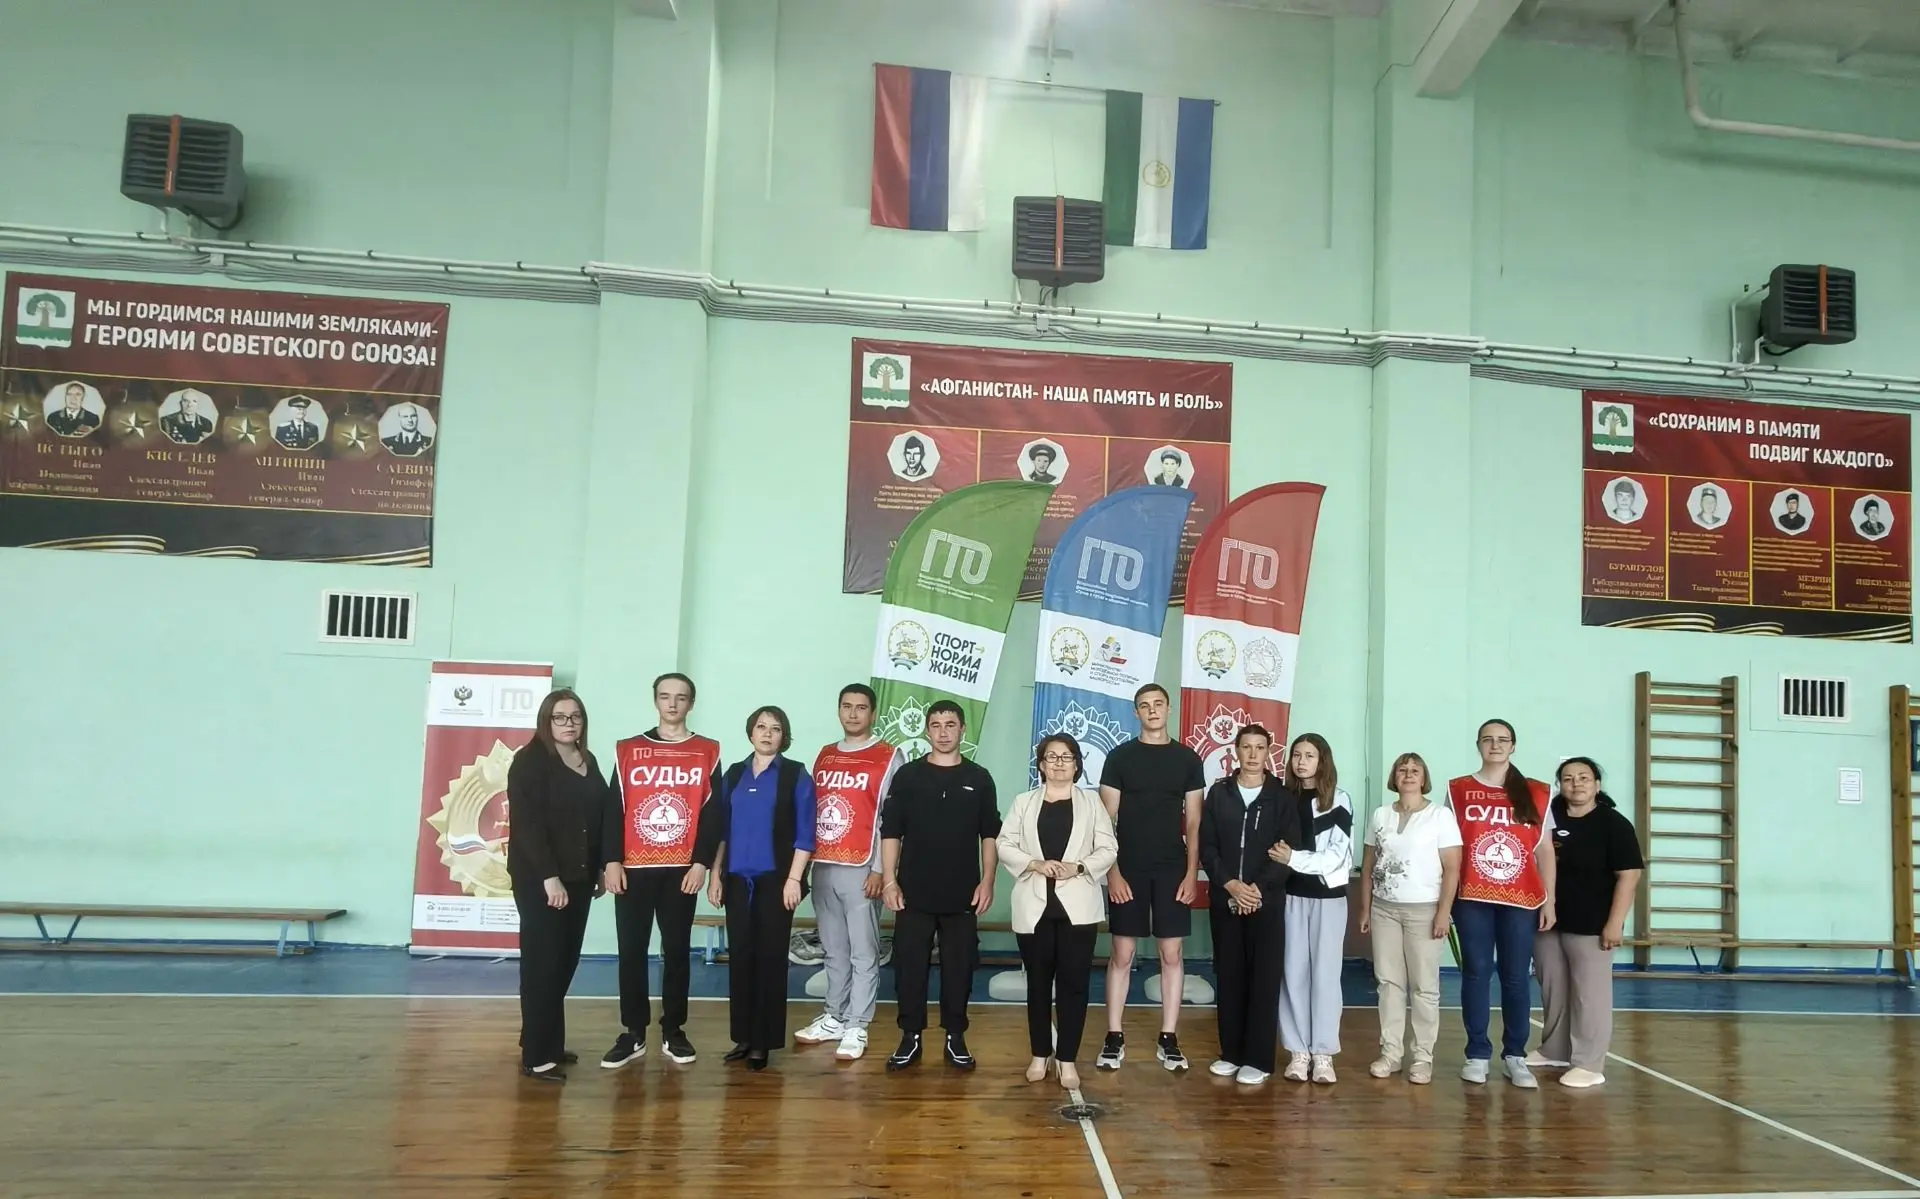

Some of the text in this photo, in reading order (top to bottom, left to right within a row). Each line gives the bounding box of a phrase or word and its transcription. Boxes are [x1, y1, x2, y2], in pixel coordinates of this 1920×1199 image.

[87, 299, 439, 338] МЫ ГОРДИМСЯ НАШИМИ ЗЕМЛЯКАМИ-
[84, 324, 437, 367] ГЕРОЯМИ СОВЕТСКОГО СОЮЗА!
[920, 377, 1223, 410] «АФГАНИСТАН- НАША ПАМЯТЬ И БОЛЬ»
[1649, 412, 1820, 440] «СОХРАНИМ В ПАМЯТИ
[1749, 443, 1894, 469] ПОДВИГ КАЖДОГО»
[920, 528, 993, 585] ГТО
[1078, 536, 1144, 591] ГТО
[1218, 537, 1279, 590] ГТО
[934, 632, 977, 654] СПОРТ
[931, 645, 982, 670] НОРМА
[929, 659, 978, 684] ЖИЗНИ
[630, 765, 703, 788] СУДЬЯ
[1465, 790, 1485, 800] ГТО
[1491, 860, 1507, 869] ГТО
